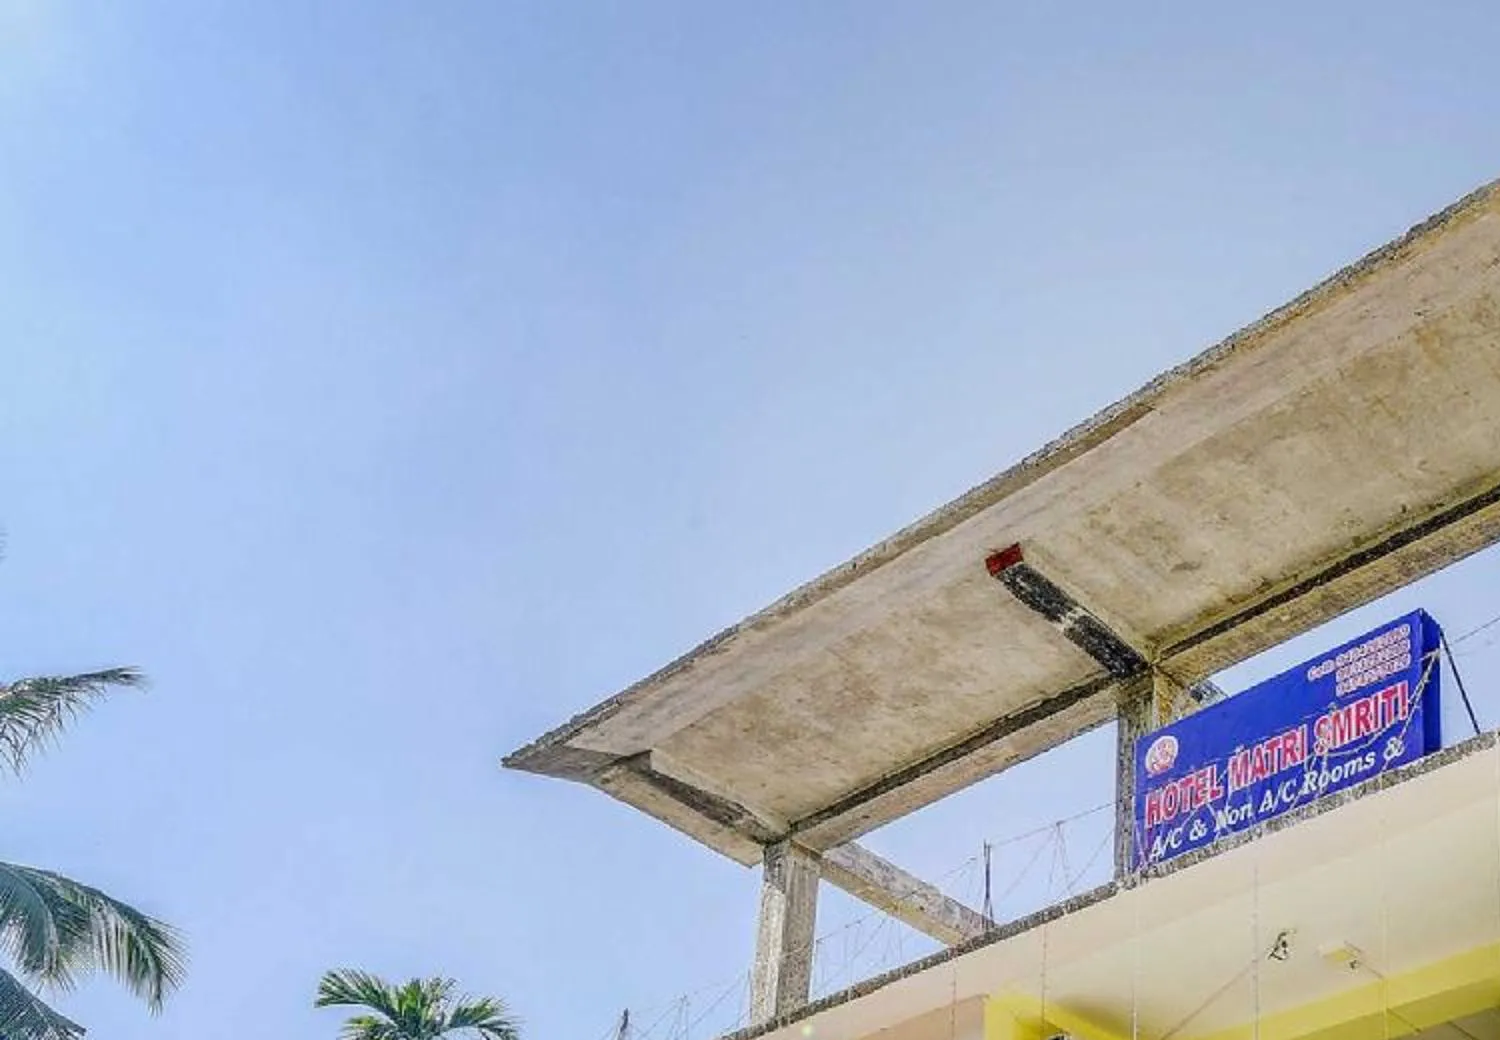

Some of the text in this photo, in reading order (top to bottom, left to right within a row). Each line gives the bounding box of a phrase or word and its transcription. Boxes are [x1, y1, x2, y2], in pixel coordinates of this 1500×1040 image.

[1145, 680, 1409, 829] HOTEL MATRI SMRITI
[1149, 826, 1184, 861] A/C
[1189, 819, 1208, 841] &
[1214, 803, 1253, 832] Non
[1258, 778, 1297, 813] A/C
[1298, 751, 1376, 796] Rooms
